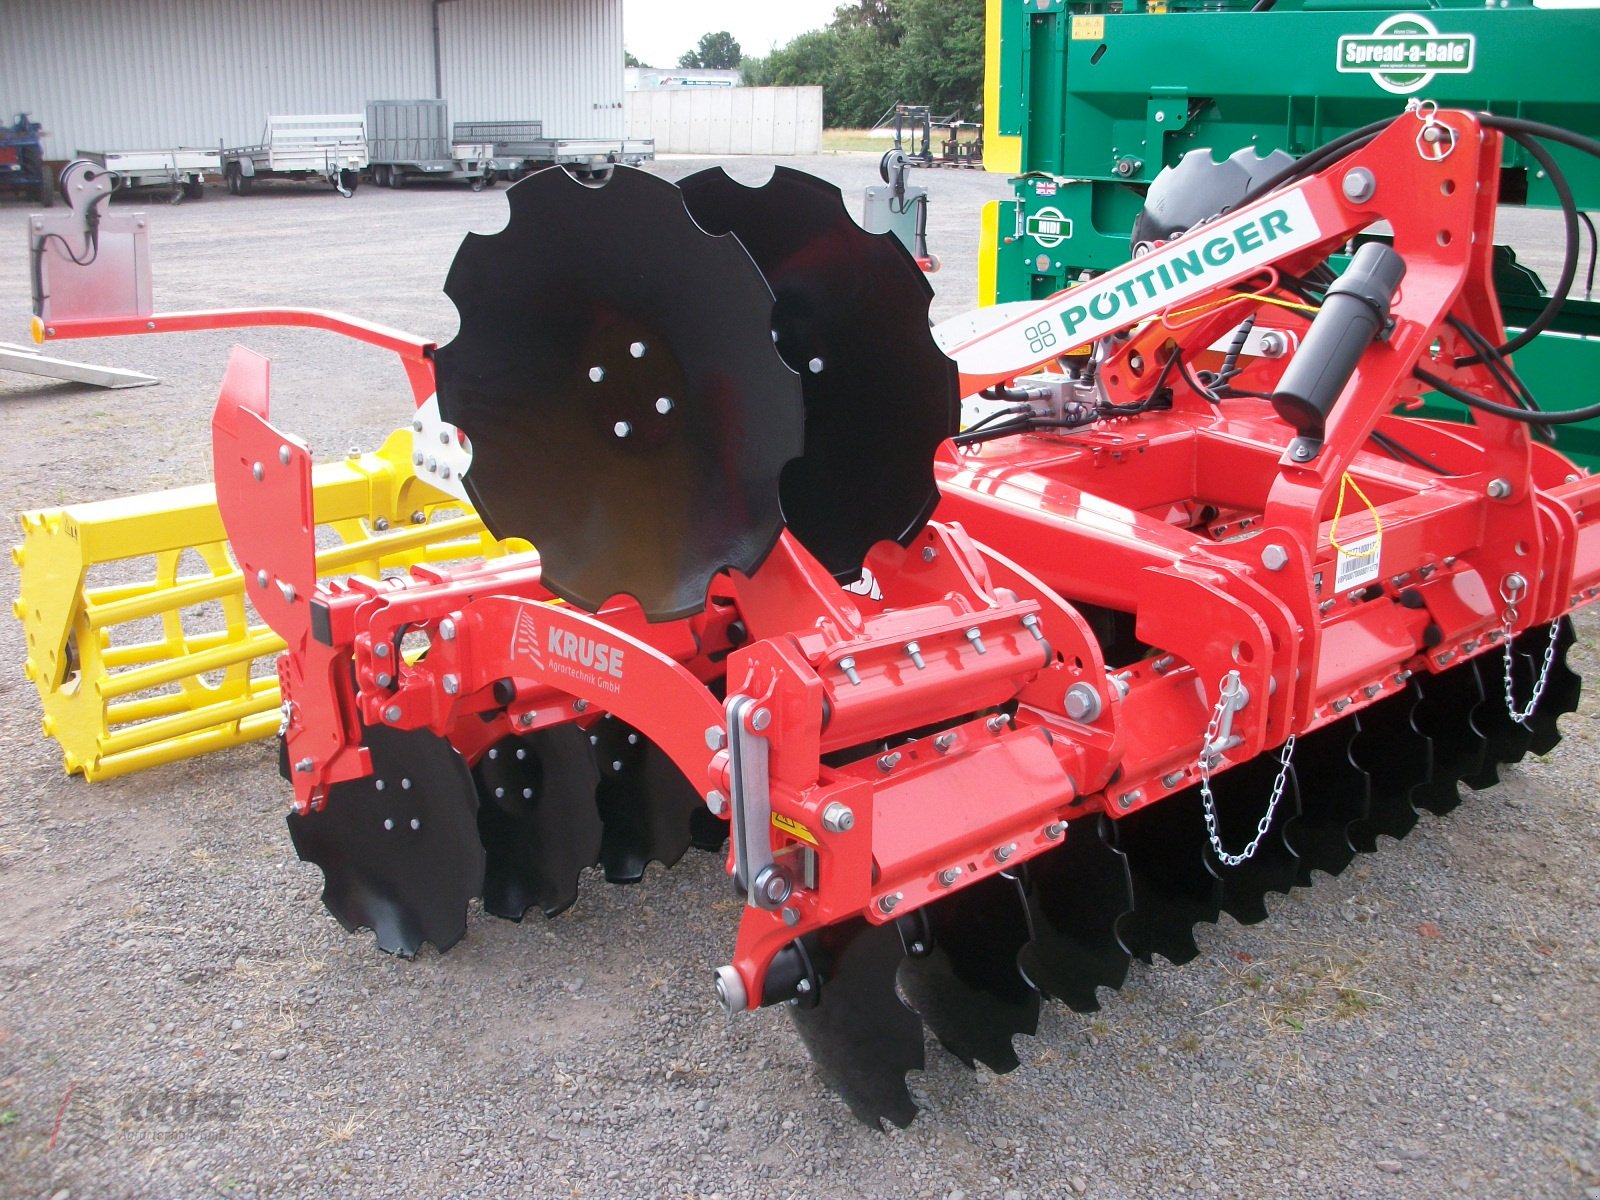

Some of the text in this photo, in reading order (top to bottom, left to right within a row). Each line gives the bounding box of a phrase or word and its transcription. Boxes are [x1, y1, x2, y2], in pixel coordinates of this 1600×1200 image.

[1038, 220, 1060, 235] MIDI
[1060, 209, 1293, 336] PÖTTINGER
[548, 626, 624, 678] KRUSE
[548, 659, 620, 694] Agrartechnik GmbH
